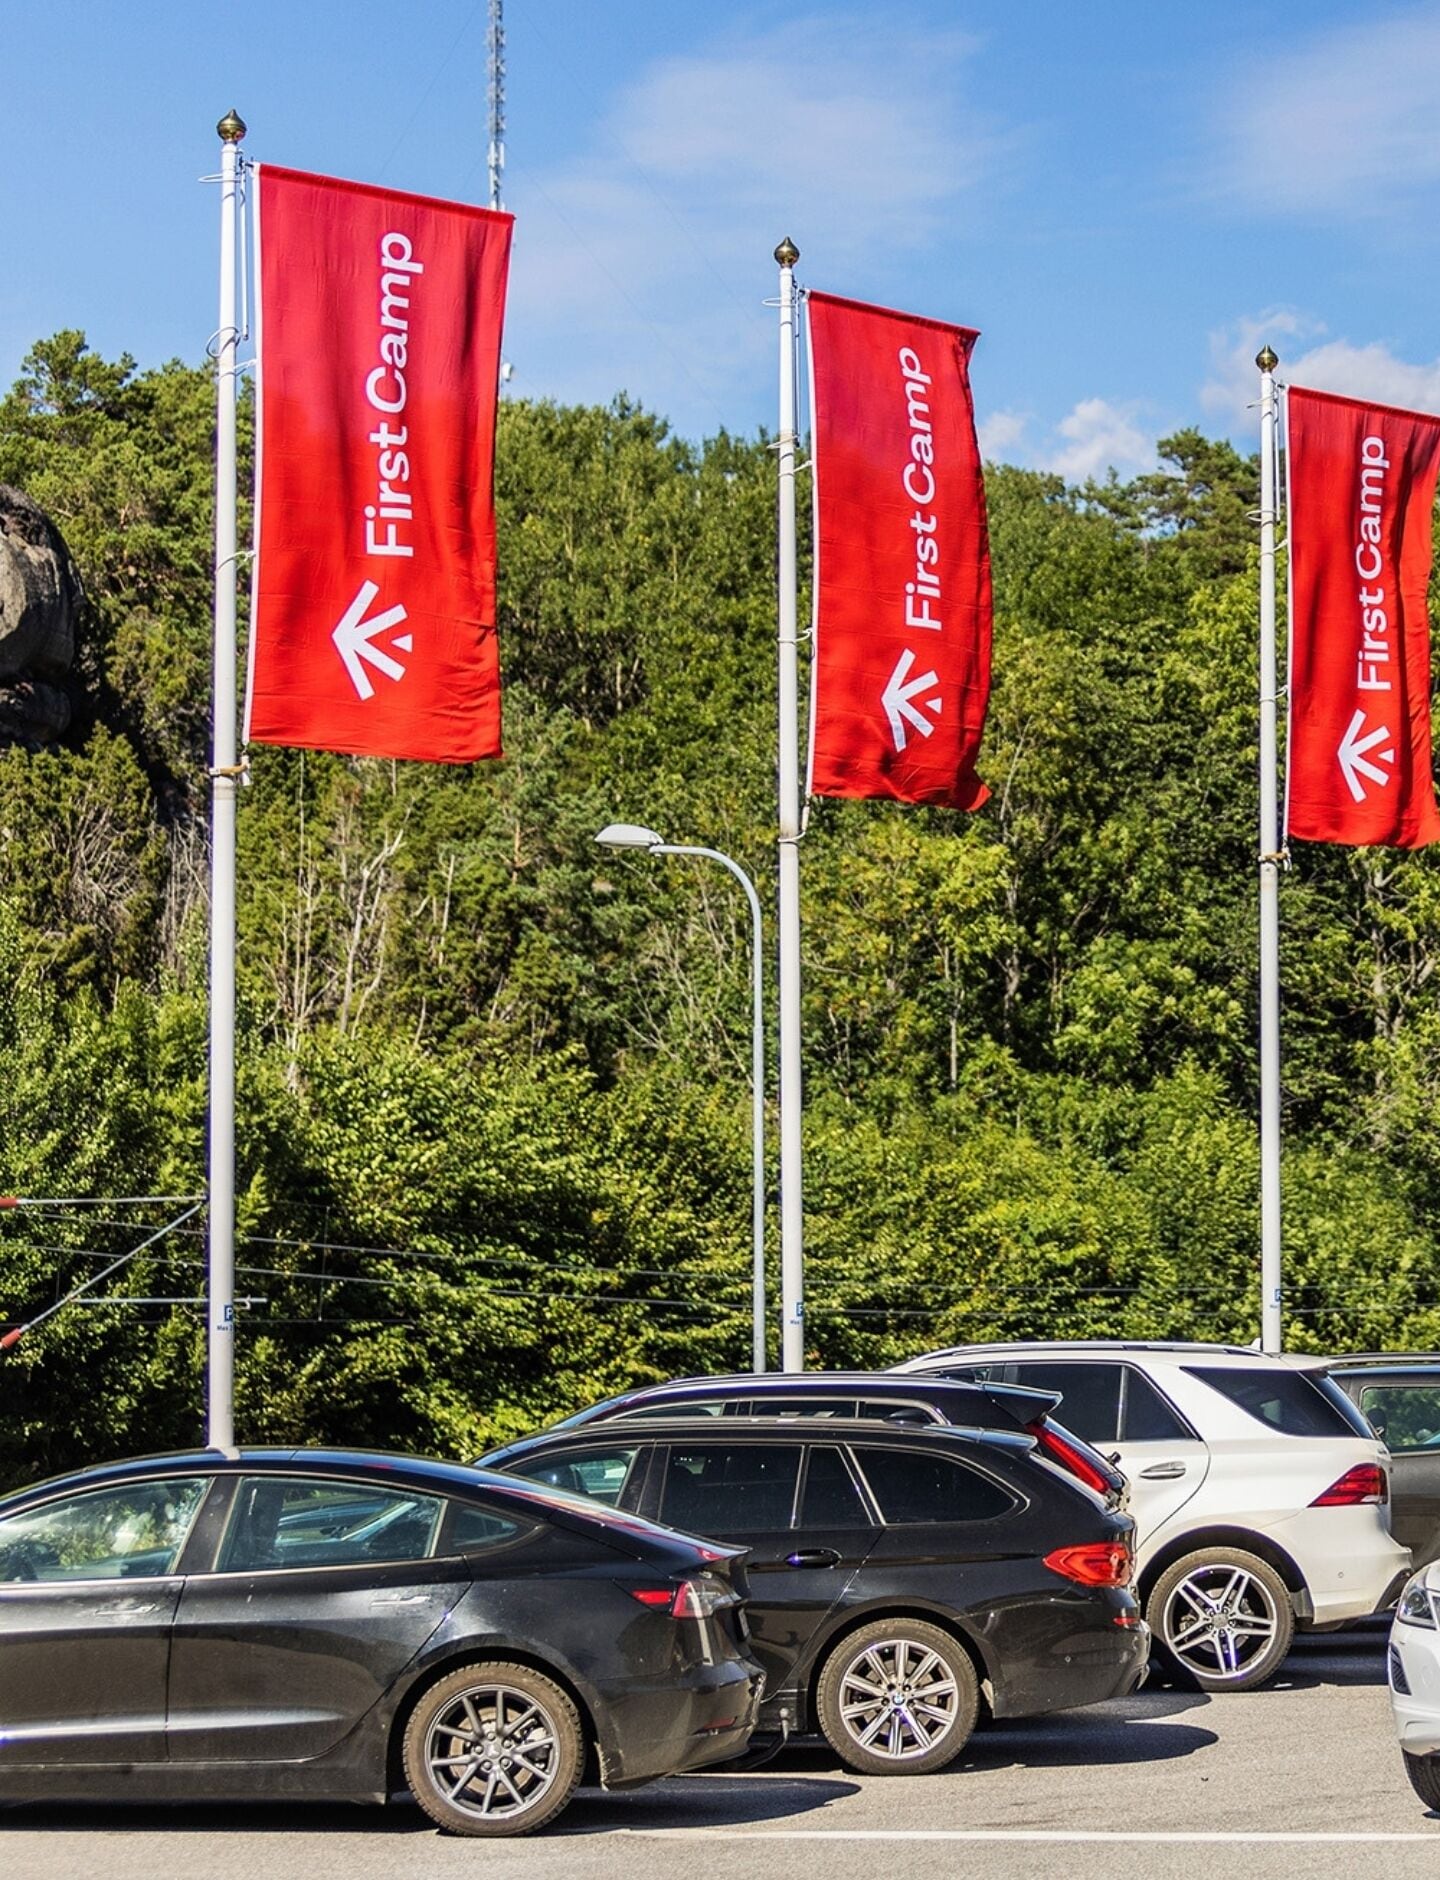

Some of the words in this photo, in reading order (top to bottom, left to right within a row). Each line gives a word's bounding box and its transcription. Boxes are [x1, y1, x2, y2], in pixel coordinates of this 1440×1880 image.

[365, 232, 424, 414] Camp
[363, 422, 414, 557] First
[899, 347, 935, 505] Camp
[905, 510, 942, 631] First
[1355, 436, 1390, 580] Camp
[1357, 587, 1392, 691] First
